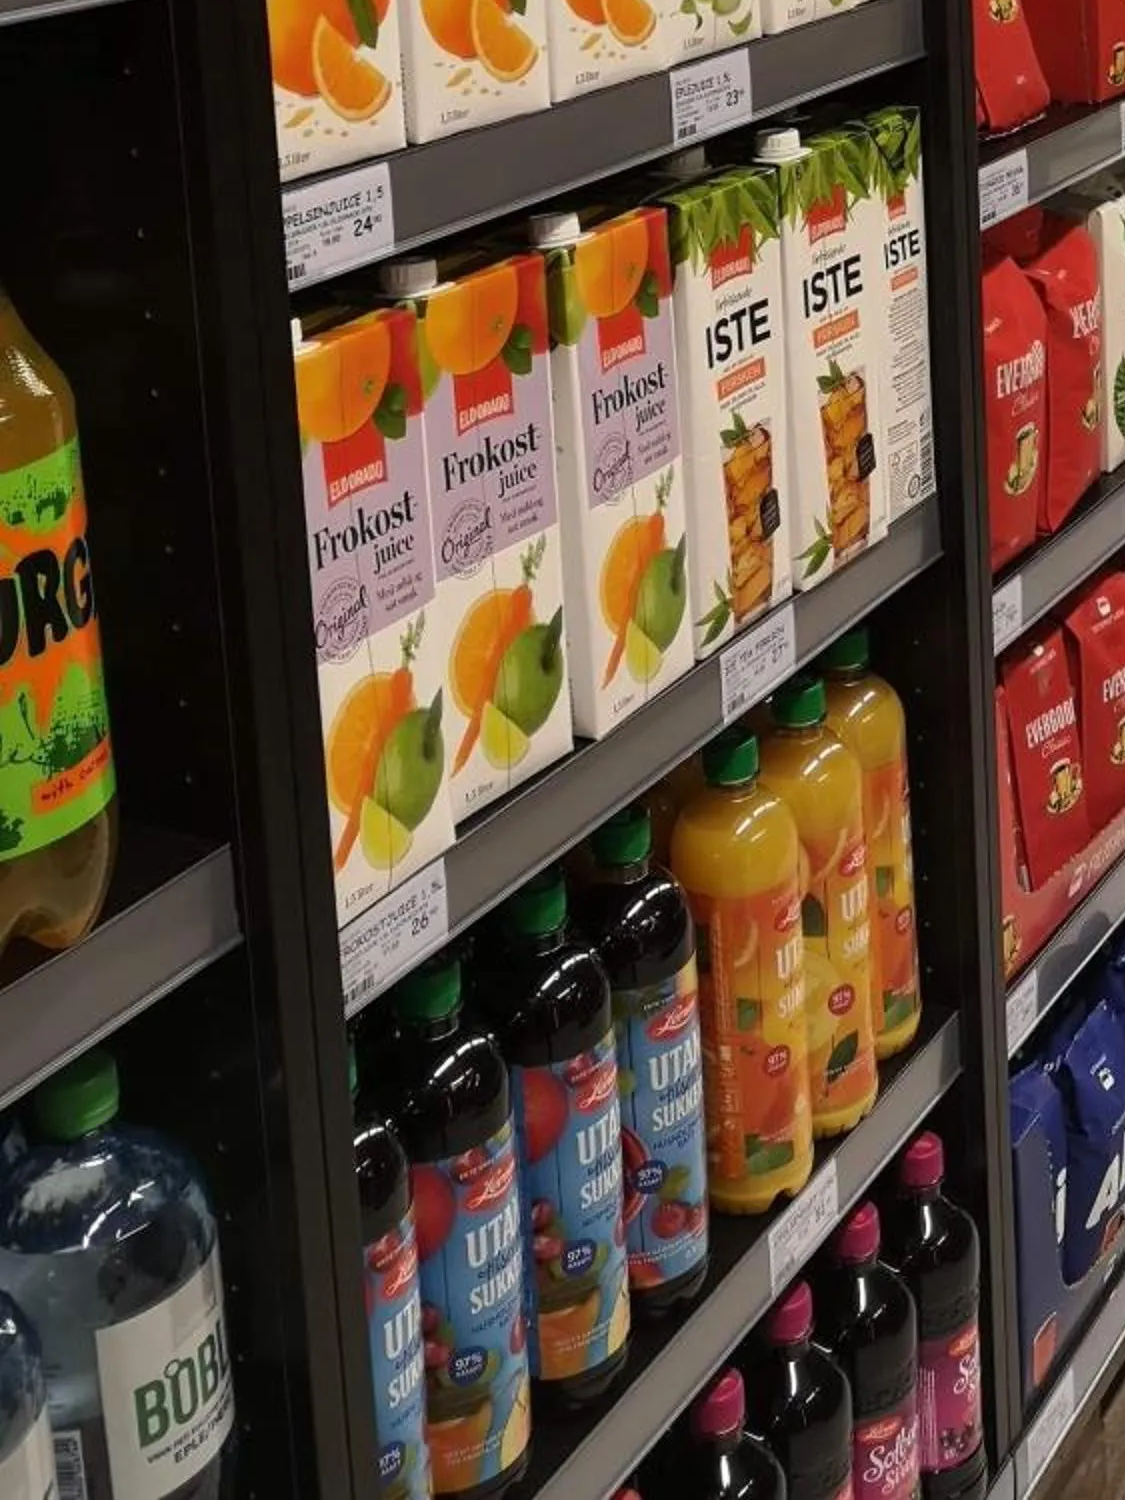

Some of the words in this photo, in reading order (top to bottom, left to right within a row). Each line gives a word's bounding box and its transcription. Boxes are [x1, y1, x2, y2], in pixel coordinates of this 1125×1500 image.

[353, 215, 373, 237] 24
[886, 230, 922, 277] ISTE
[803, 253, 864, 320] ISTE
[706, 297, 771, 370] ISTE
[459, 393, 512, 432] ELDORADO
[634, 396, 667, 431] juice
[330, 459, 385, 501] ELDORADO
[498, 463, 538, 500] juice
[374, 533, 416, 576] juice
[440, 506, 494, 566] Original
